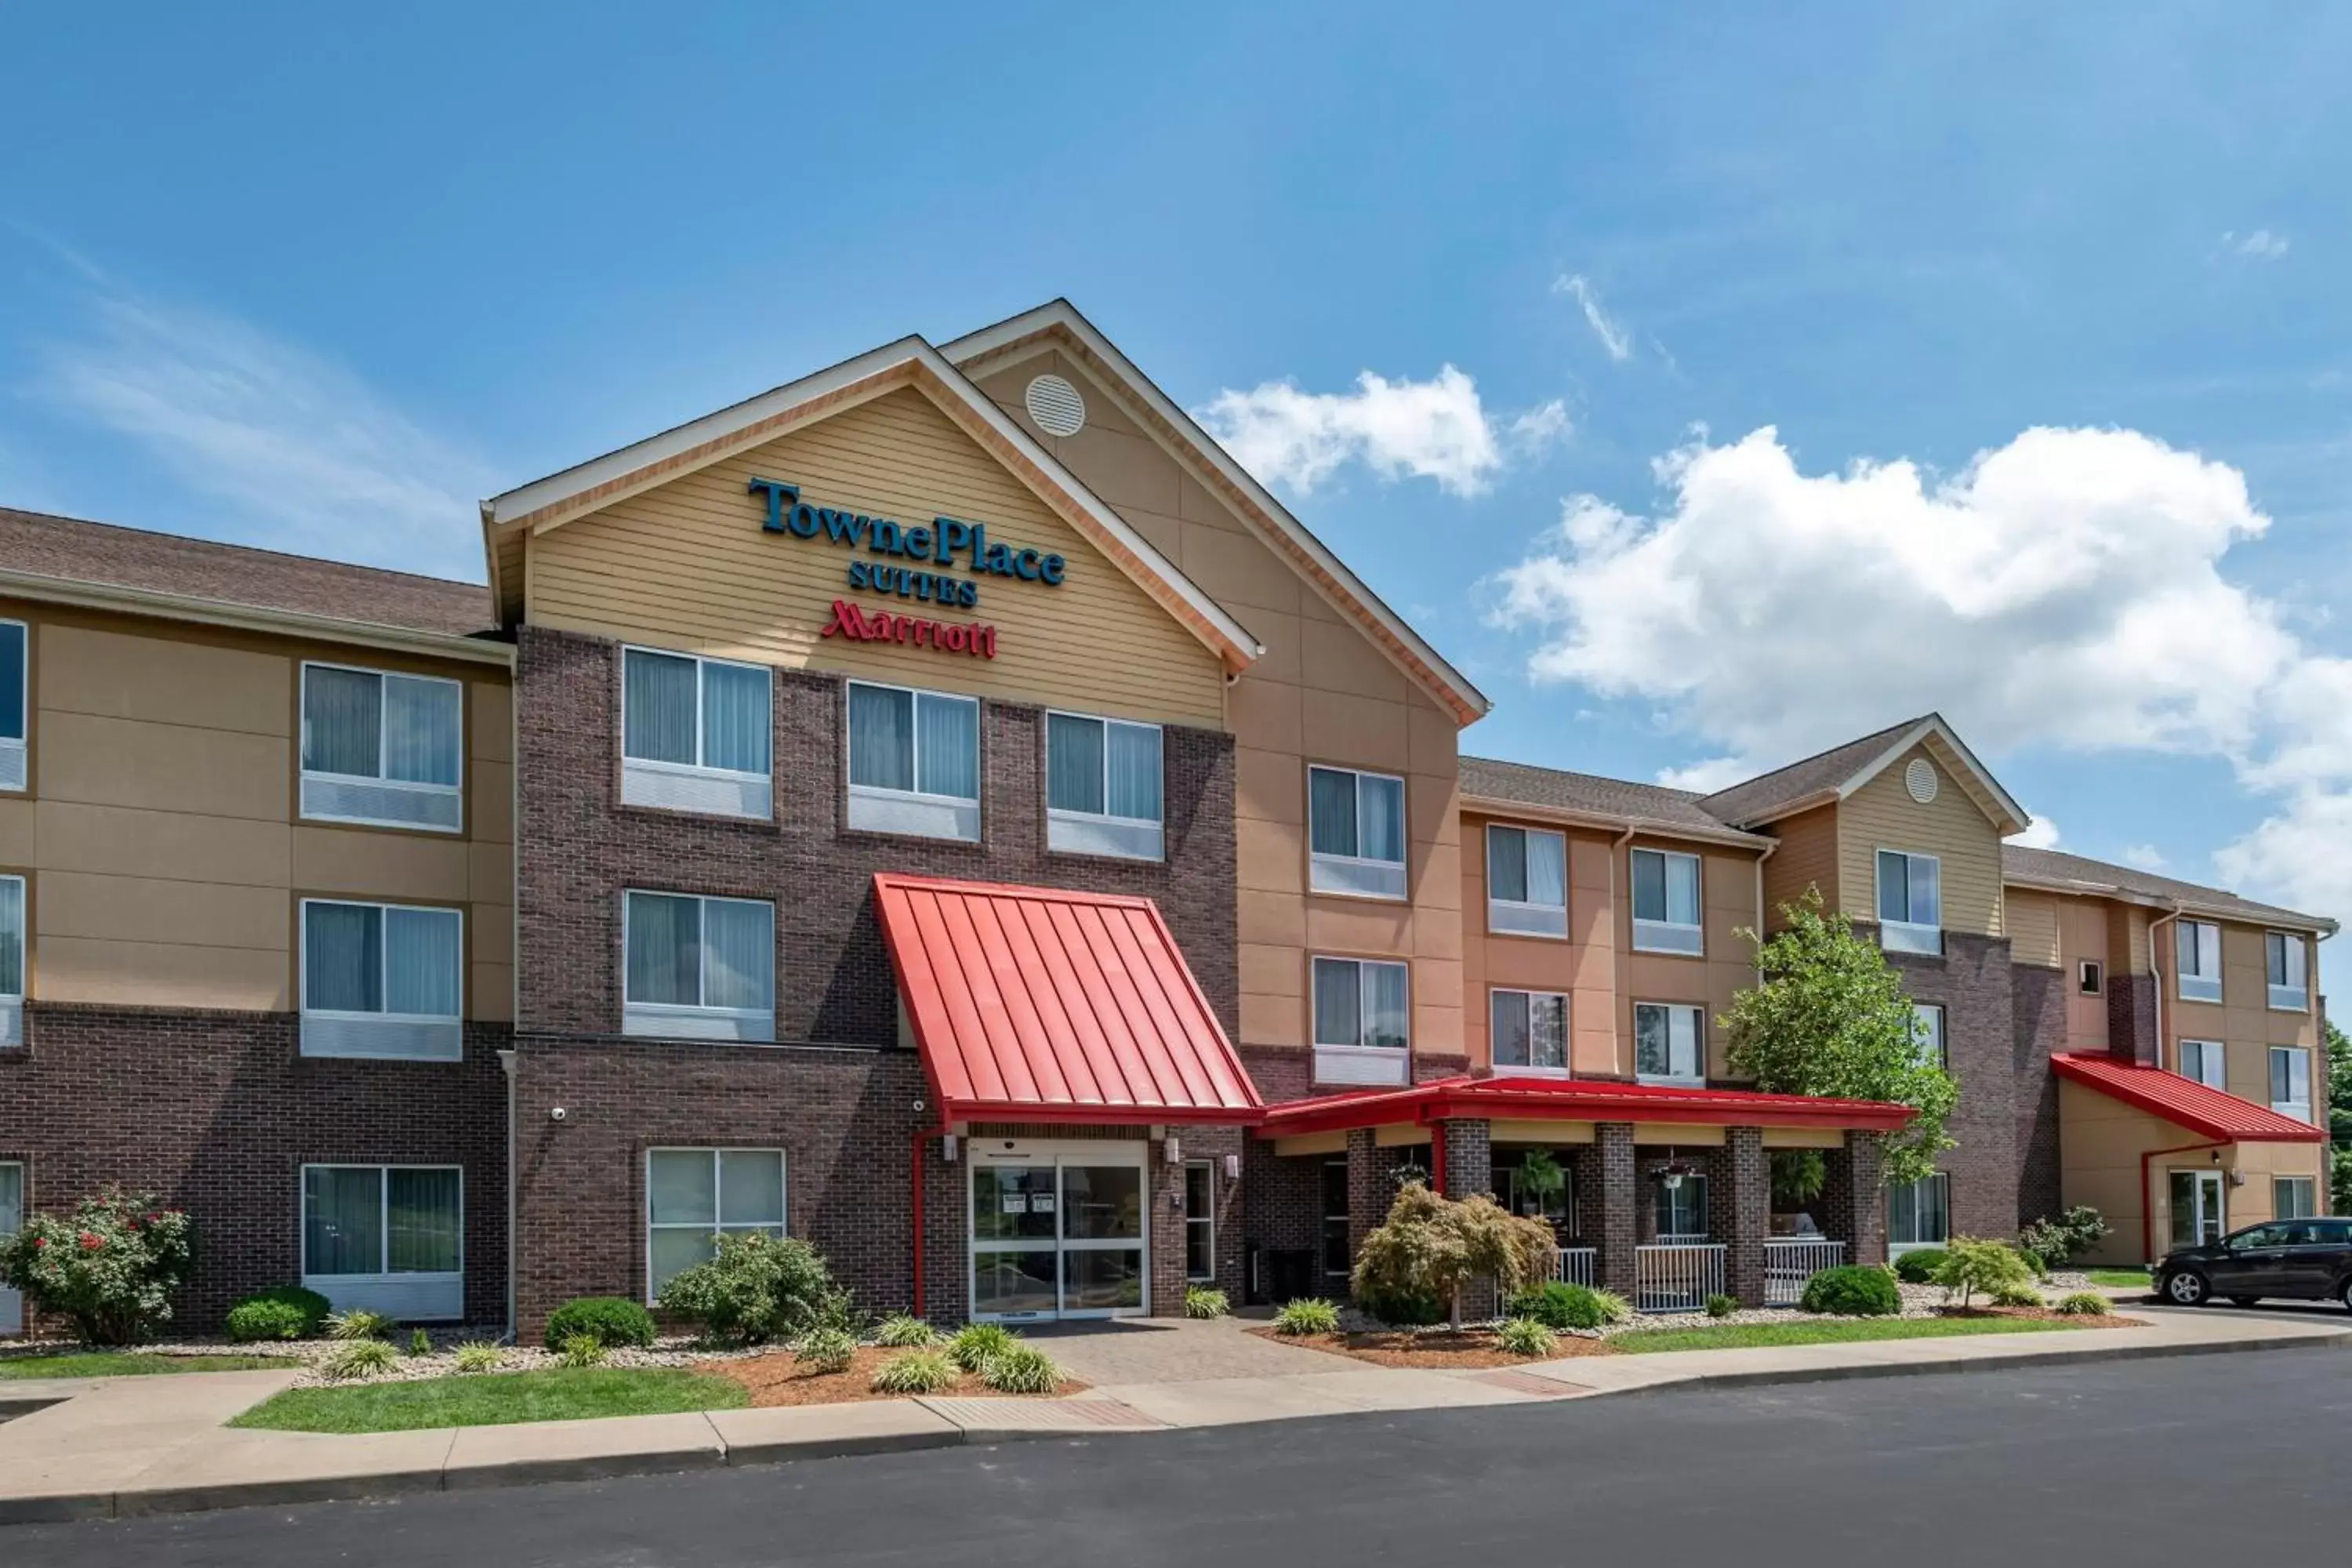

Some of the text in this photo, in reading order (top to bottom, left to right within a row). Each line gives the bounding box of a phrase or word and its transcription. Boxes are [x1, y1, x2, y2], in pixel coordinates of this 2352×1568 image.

[748, 477, 1065, 586] TownePlace
[848, 561, 978, 607] SUITES
[820, 600, 997, 659] Marriott
